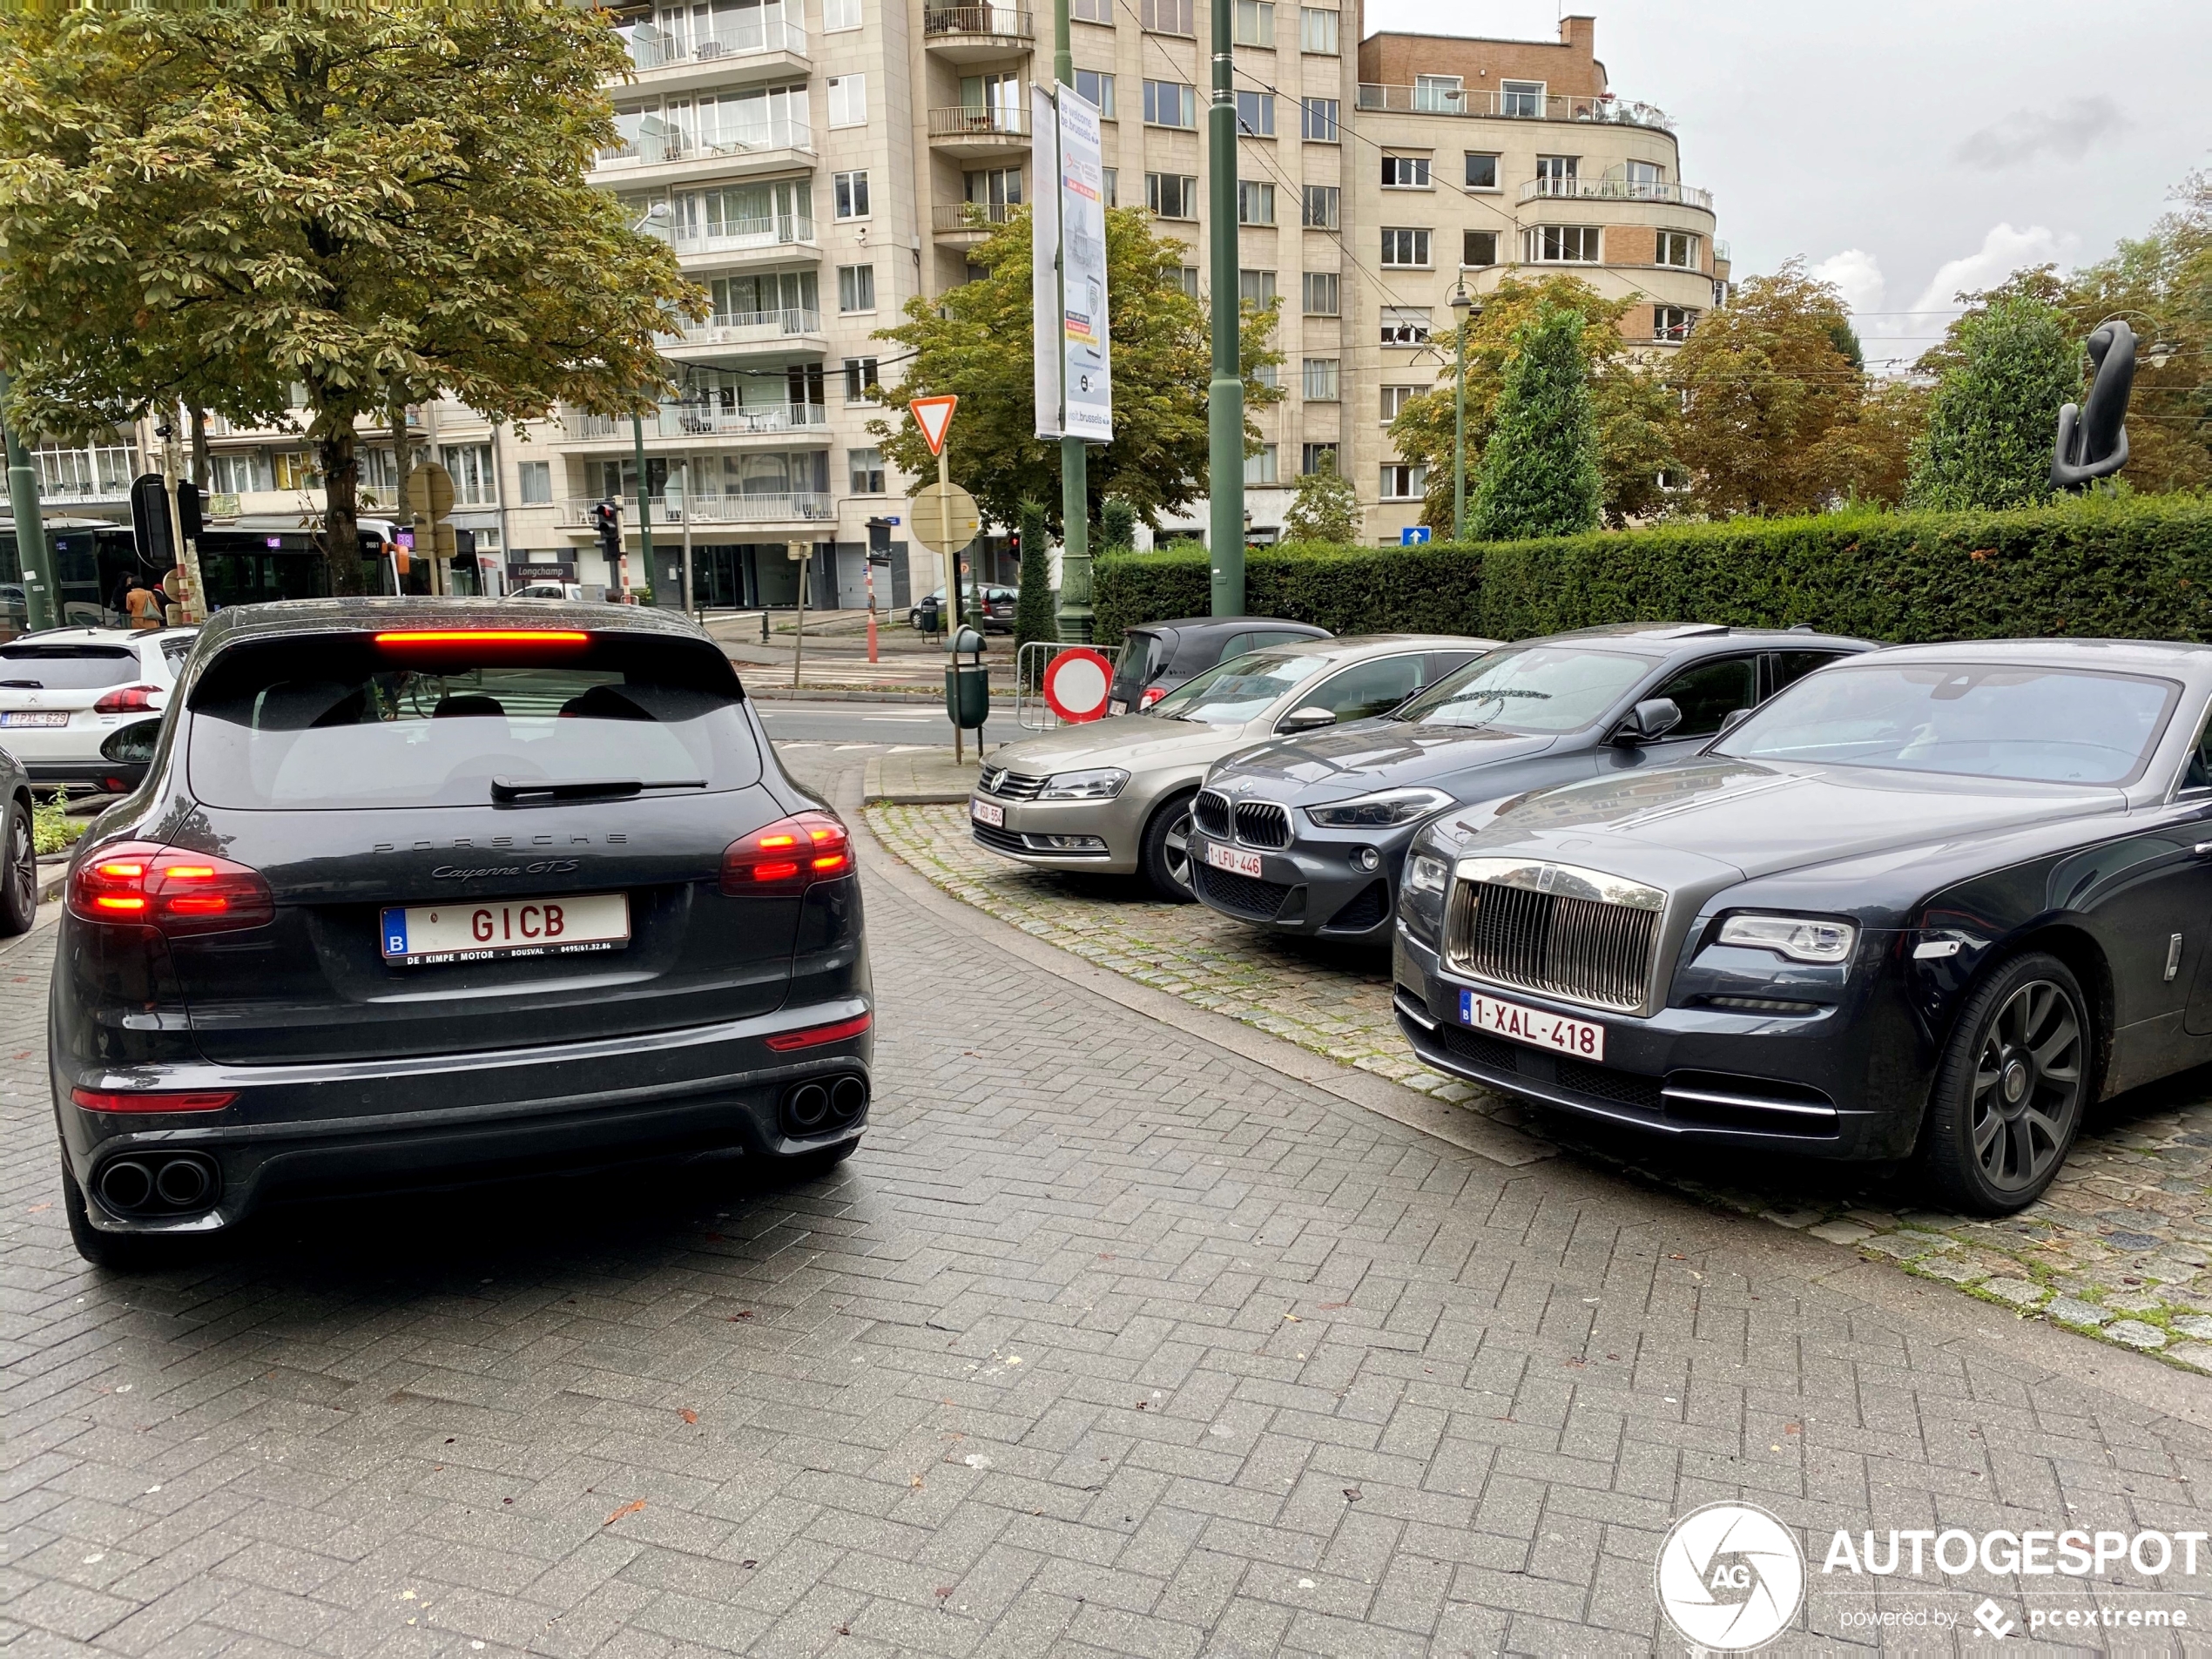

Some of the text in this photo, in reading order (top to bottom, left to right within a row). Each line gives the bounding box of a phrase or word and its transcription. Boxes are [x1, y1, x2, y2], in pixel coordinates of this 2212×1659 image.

[1069, 106, 1092, 128] welcome
[1068, 409, 1103, 425] visit.brussels
[518, 566, 563, 577] Longchamp
[372, 833, 630, 854] PORSCHE
[431, 860, 579, 883] Cayenne GTS
[1210, 847, 1259, 874] 1-LFU-446
[389, 935, 403, 952] B
[407, 956, 420, 965] DE
[426, 954, 455, 963] KIMPE
[461, 950, 494, 961] MOTOR
[511, 947, 544, 957] BOUSVAL
[561, 942, 611, 953] 0495/61.32.86
[1462, 999, 1595, 1054] B 1-XAL-418
